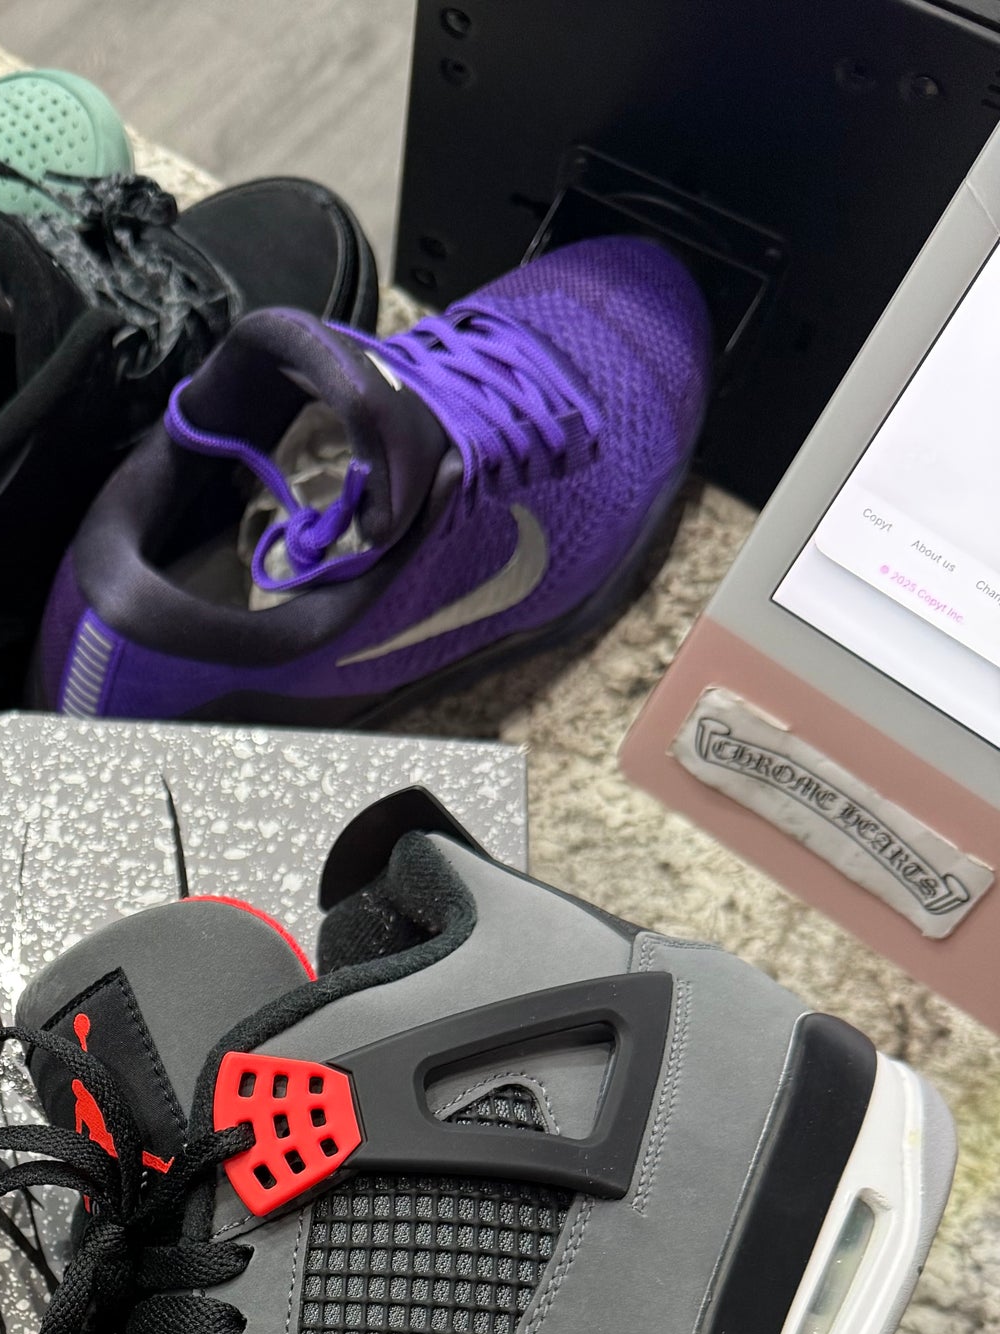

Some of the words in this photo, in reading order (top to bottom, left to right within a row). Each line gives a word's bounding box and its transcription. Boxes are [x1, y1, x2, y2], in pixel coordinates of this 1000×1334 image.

[863, 508, 893, 532] Copyt
[911, 540, 942, 563] About
[942, 560, 956, 573] us
[890, 572, 917, 592] 2025
[917, 589, 947, 612] Copyt
[976, 580, 1000, 606] Chan
